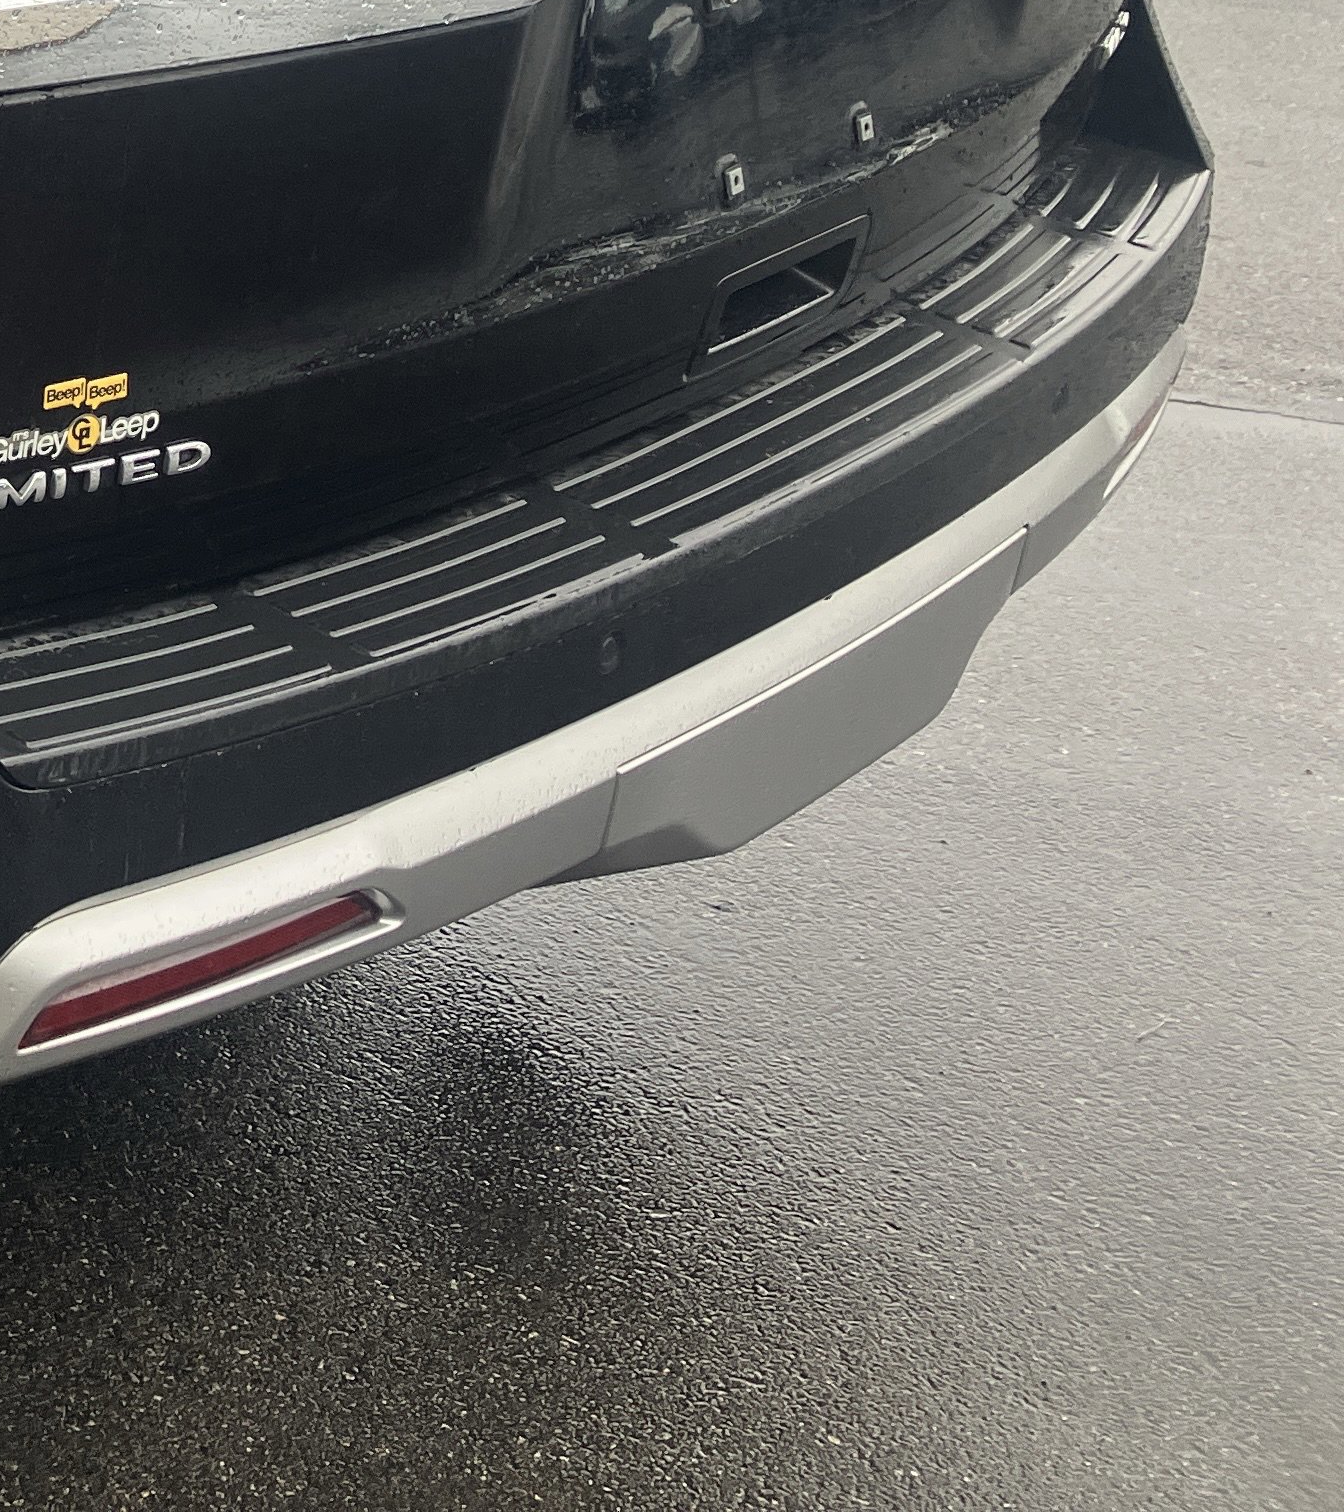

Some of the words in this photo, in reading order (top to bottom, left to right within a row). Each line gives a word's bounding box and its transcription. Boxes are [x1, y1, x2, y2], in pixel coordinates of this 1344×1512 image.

[46, 381, 85, 403] Beep!
[88, 378, 126, 400] Beep!
[99, 411, 160, 444] Leep
